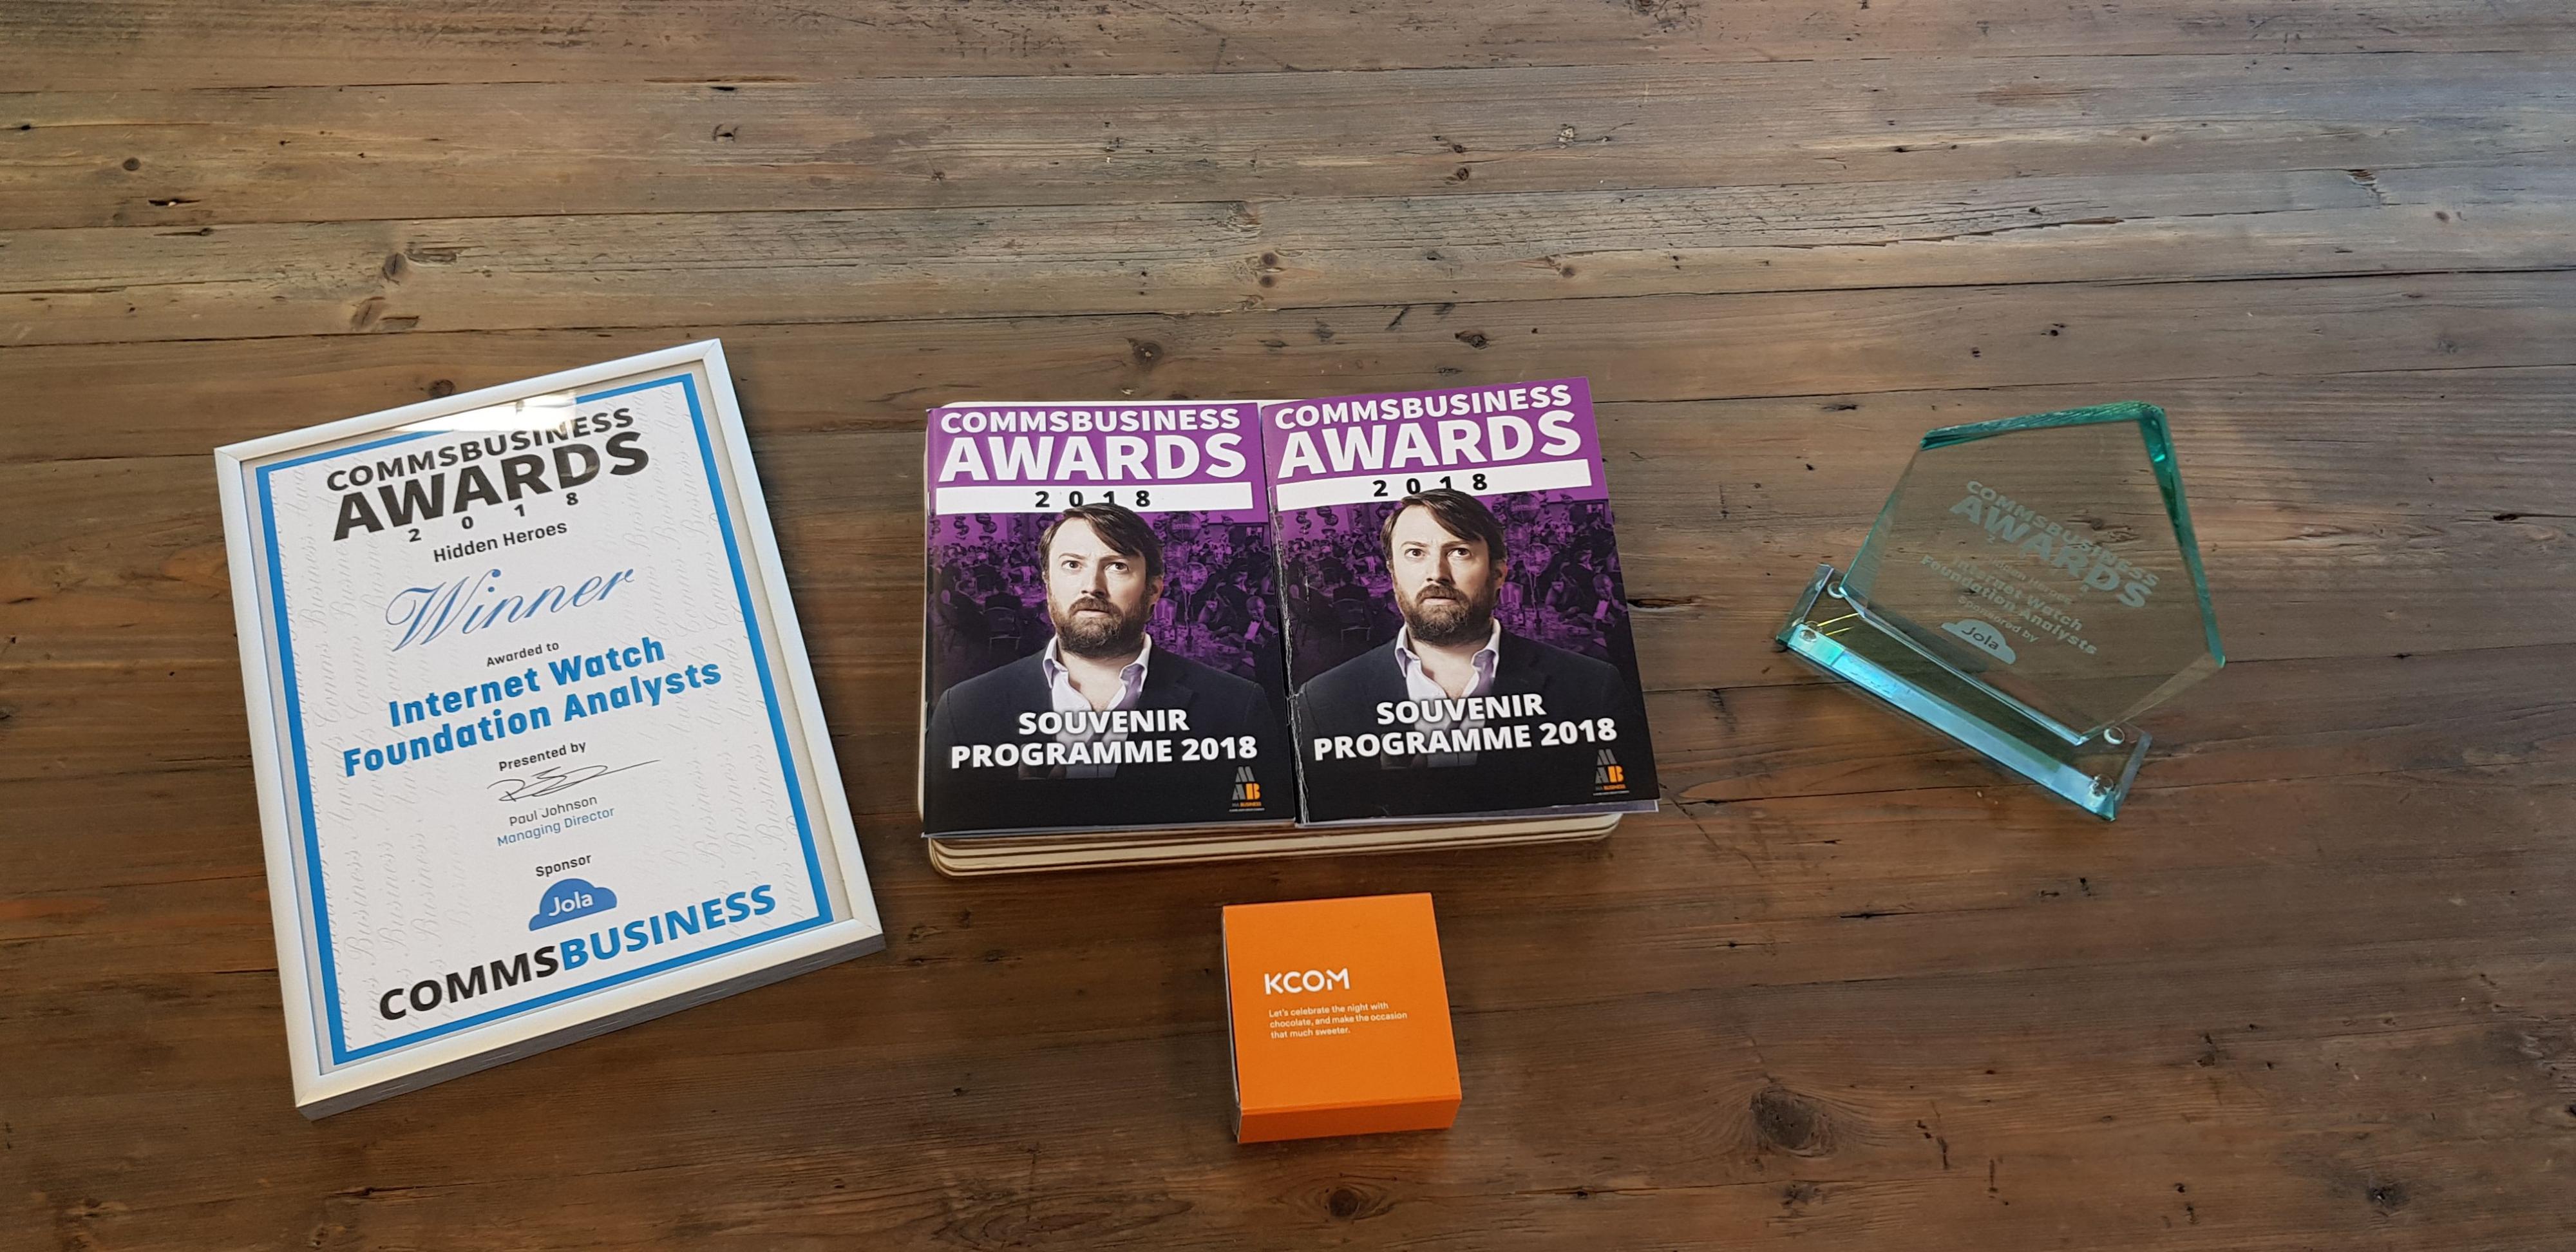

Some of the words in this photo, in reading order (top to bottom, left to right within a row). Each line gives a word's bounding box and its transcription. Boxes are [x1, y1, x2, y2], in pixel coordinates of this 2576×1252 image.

[940, 408, 1241, 434] COMMSBUSINESS
[1274, 384, 1572, 430] COMMSBUSINESS
[327, 407, 634, 491] COMMSBUSINESS
[938, 432, 1247, 482] AWARDS
[1277, 410, 1582, 479] AWARDS
[333, 431, 650, 541] AWARDS
[1034, 490, 1151, 509] 2018
[1373, 473, 1488, 497] 2018
[433, 532, 499, 564] Hidden
[502, 522, 567, 547] Heroes
[1967, 480, 2160, 587] COMMSBUSINESS
[1949, 495, 2154, 607] AWARDS
[386, 568, 634, 652] Winner
[1920, 555, 2016, 611] Foundation
[2018, 609, 2098, 654] Analysts
[2027, 595, 2083, 631] Watch
[1961, 627, 2000, 650] Jola
[2022, 629, 2040, 643] by
[486, 645, 544, 668] Awarded
[546, 641, 560, 654] to
[388, 667, 541, 728] Internet
[547, 636, 666, 687] Watch
[343, 701, 552, 778] Foundation
[564, 663, 723, 723] Analysts
[1018, 708, 1190, 735] SOUVENIR
[1376, 693, 1546, 725] SOUVENIR
[498, 743, 568, 772] Presented
[571, 740, 587, 757] by
[951, 739, 1173, 769] PROGRAMME
[1181, 735, 1258, 762] 2018
[1314, 725, 1532, 761] PROGRAMME
[1540, 717, 1617, 746] 2018
[496, 819, 562, 848] Managing
[564, 805, 616, 831] Director
[508, 808, 538, 827] Paul
[541, 794, 598, 820] Johnson
[535, 853, 593, 878] Sponsor
[547, 889, 594, 917] Jola
[378, 884, 777, 1021] COMMSBUSINESS
[1264, 967, 1351, 995] KCOM
[1269, 1009, 1289, 1018] Let's
[1290, 1007, 1330, 1016] celebrate
[1332, 1005, 1345, 1014] the
[1347, 1003, 1368, 1013] night
[1370, 1001, 1389, 1011] with
[1269, 1018, 1314, 1029] chocolate,
[1315, 1016, 1331, 1025] and
[1332, 1014, 1354, 1023] make
[1356, 1012, 1369, 1022] the
[1370, 1011, 1407, 1021] occasion
[1289, 1029, 1313, 1038] much
[1315, 1027, 1350, 1036] sweeter.
